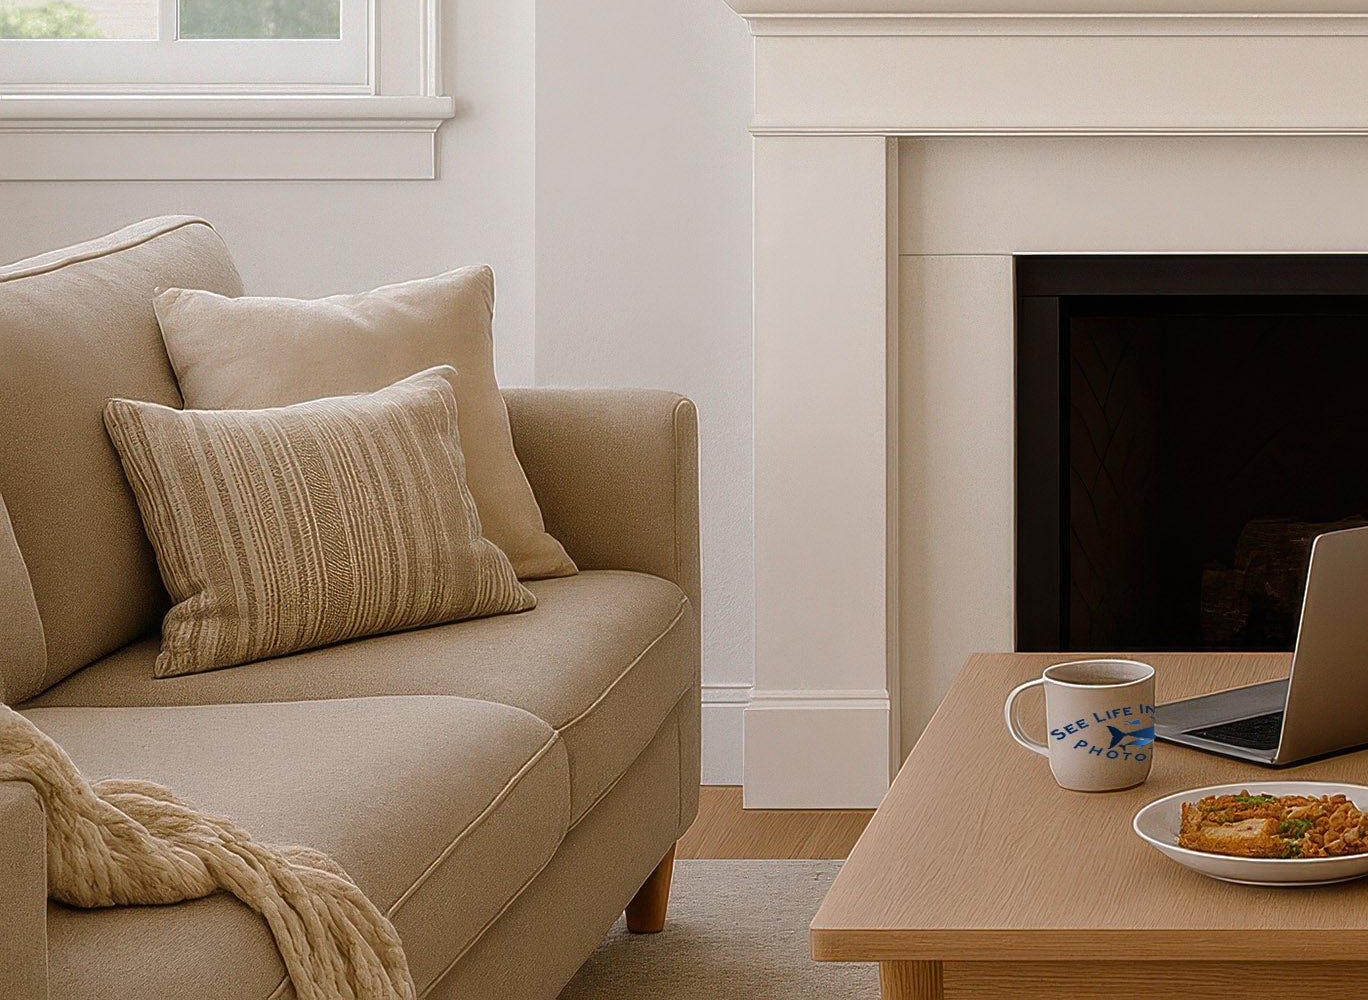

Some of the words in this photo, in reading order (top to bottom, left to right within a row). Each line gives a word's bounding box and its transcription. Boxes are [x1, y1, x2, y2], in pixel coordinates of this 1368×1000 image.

[1050, 719, 1089, 740] SEE
[1092, 706, 1133, 723] LIFE
[1139, 703, 1155, 714] IN
[1073, 739, 1153, 761] PHOTO
